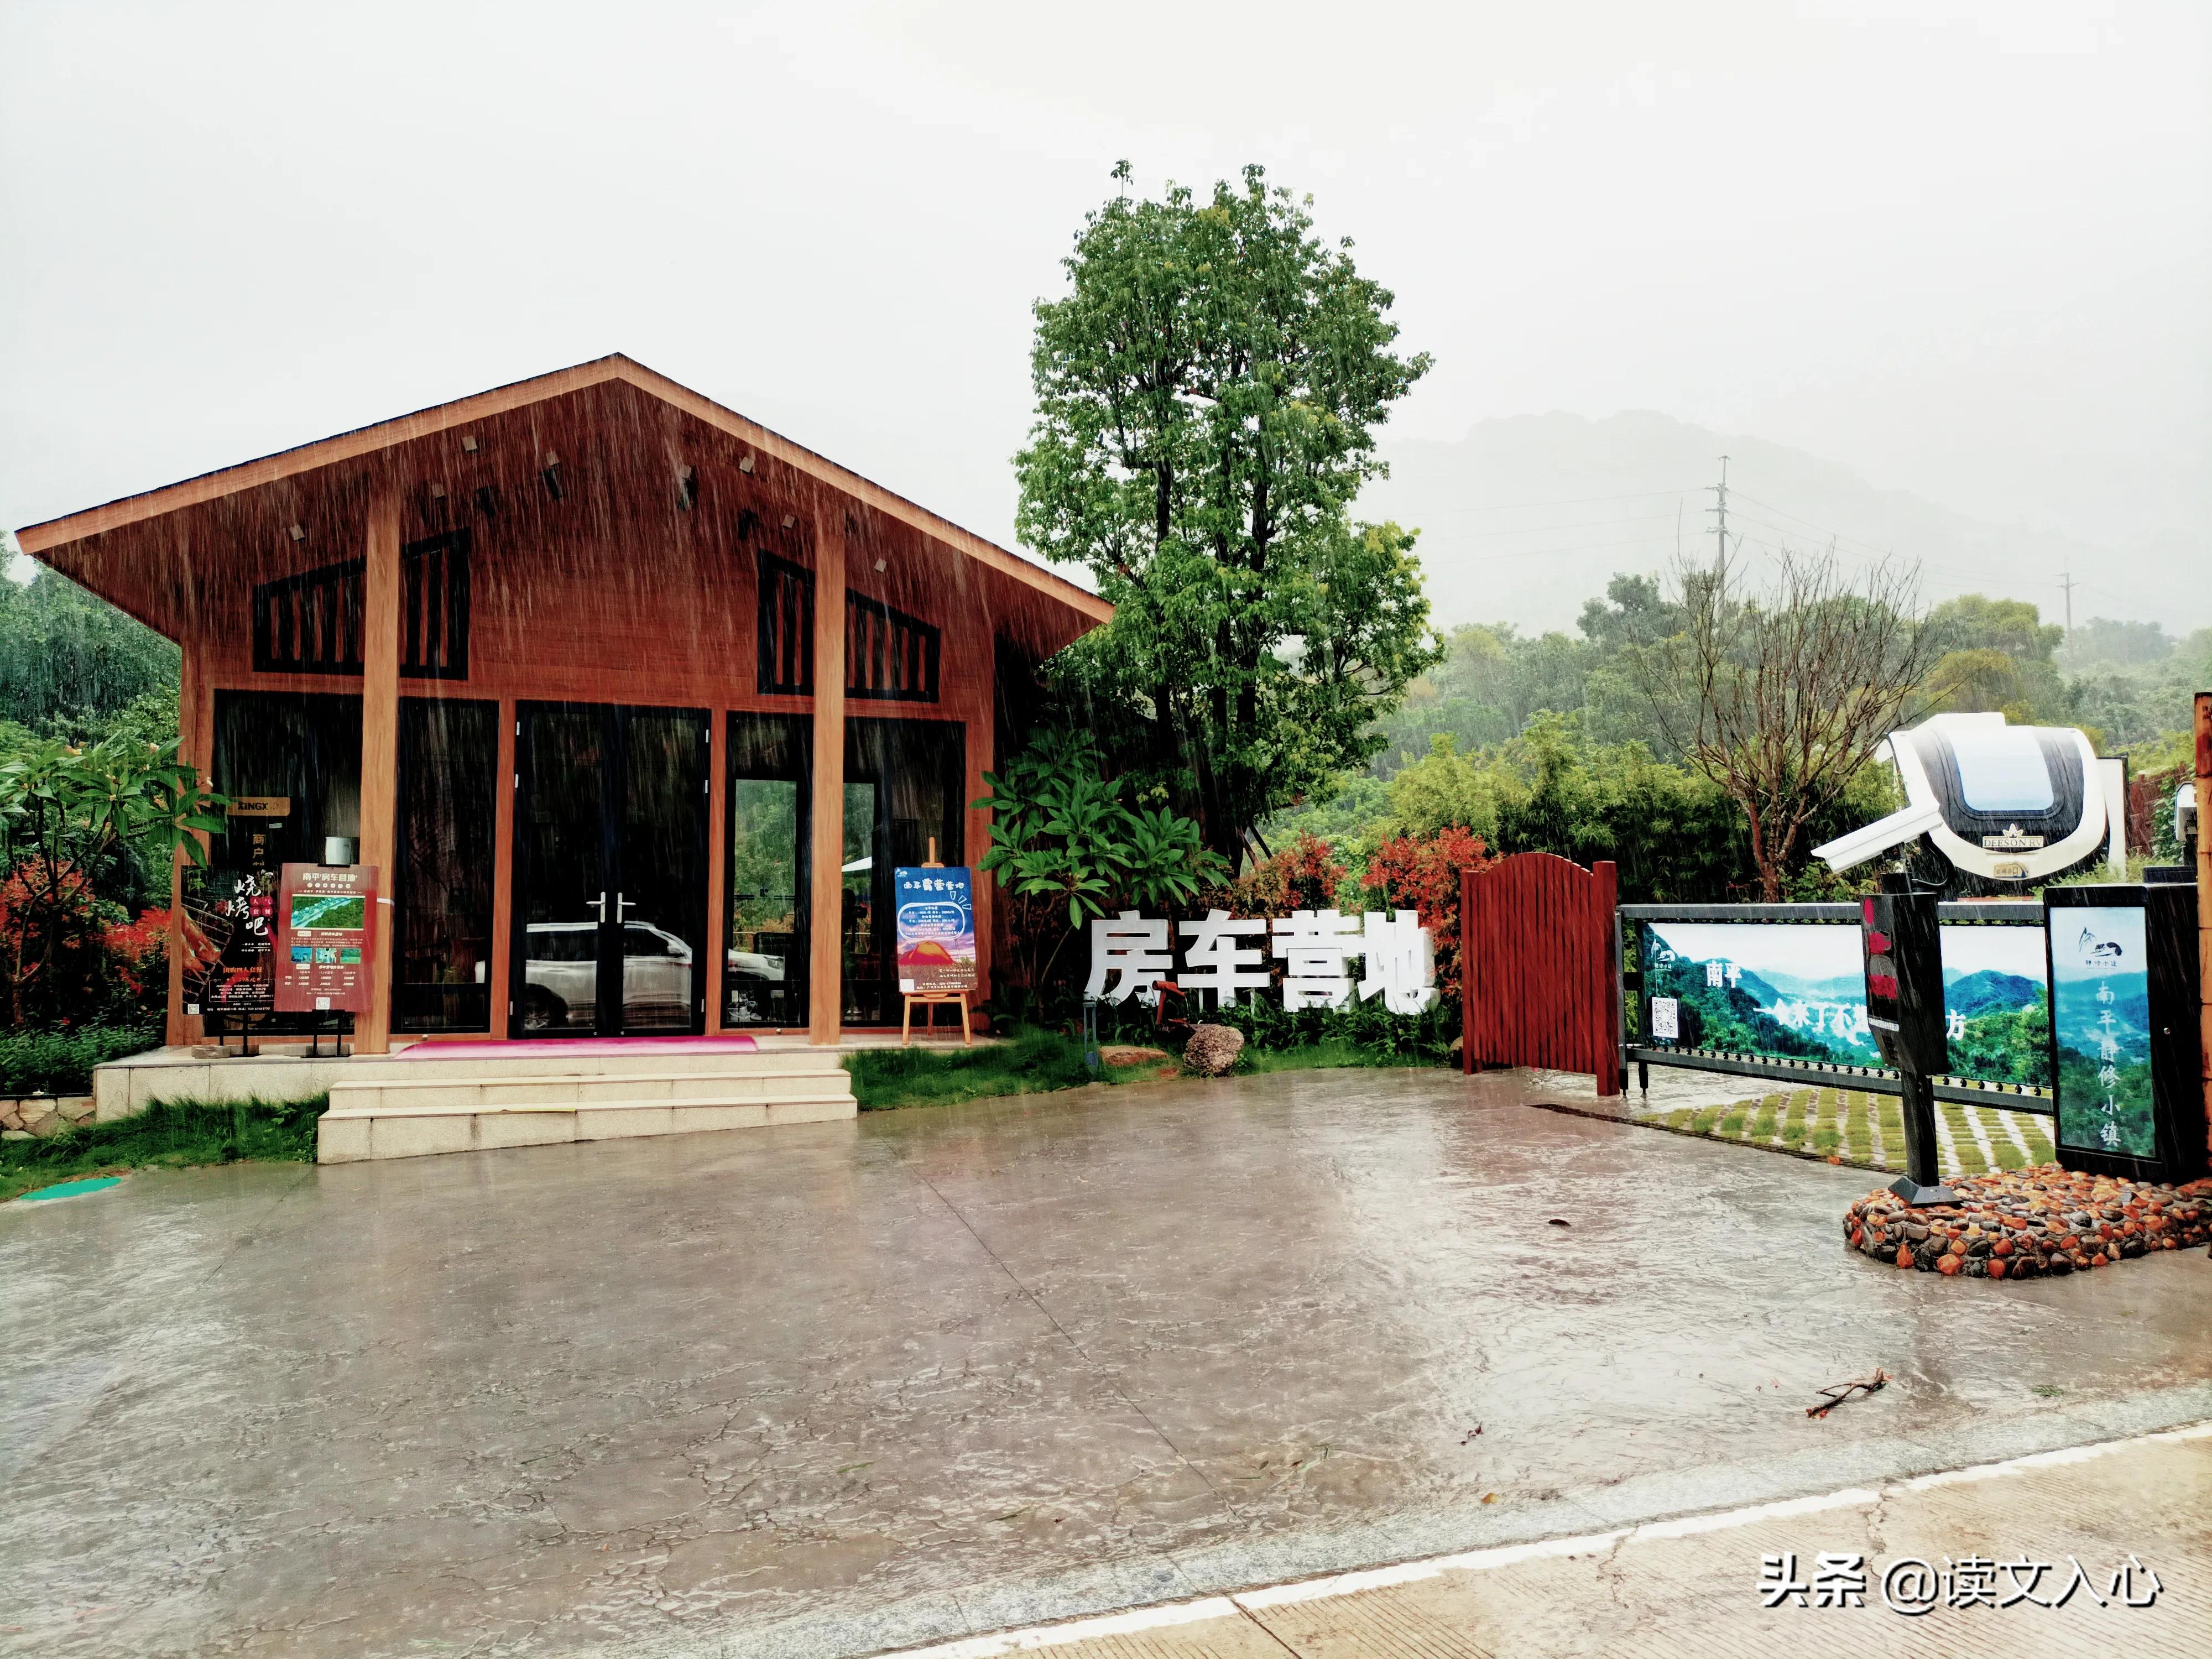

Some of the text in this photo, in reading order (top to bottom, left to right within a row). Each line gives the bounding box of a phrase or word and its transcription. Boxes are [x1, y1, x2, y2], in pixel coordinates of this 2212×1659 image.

[1984, 838, 2042, 847] DEESON RV
[225, 874, 269, 936] 烧烤吧
[1084, 909, 1440, 1015] 房车营地
[1705, 959, 1743, 988] 南平
[2095, 980, 2122, 1147] 南平静修小镇
